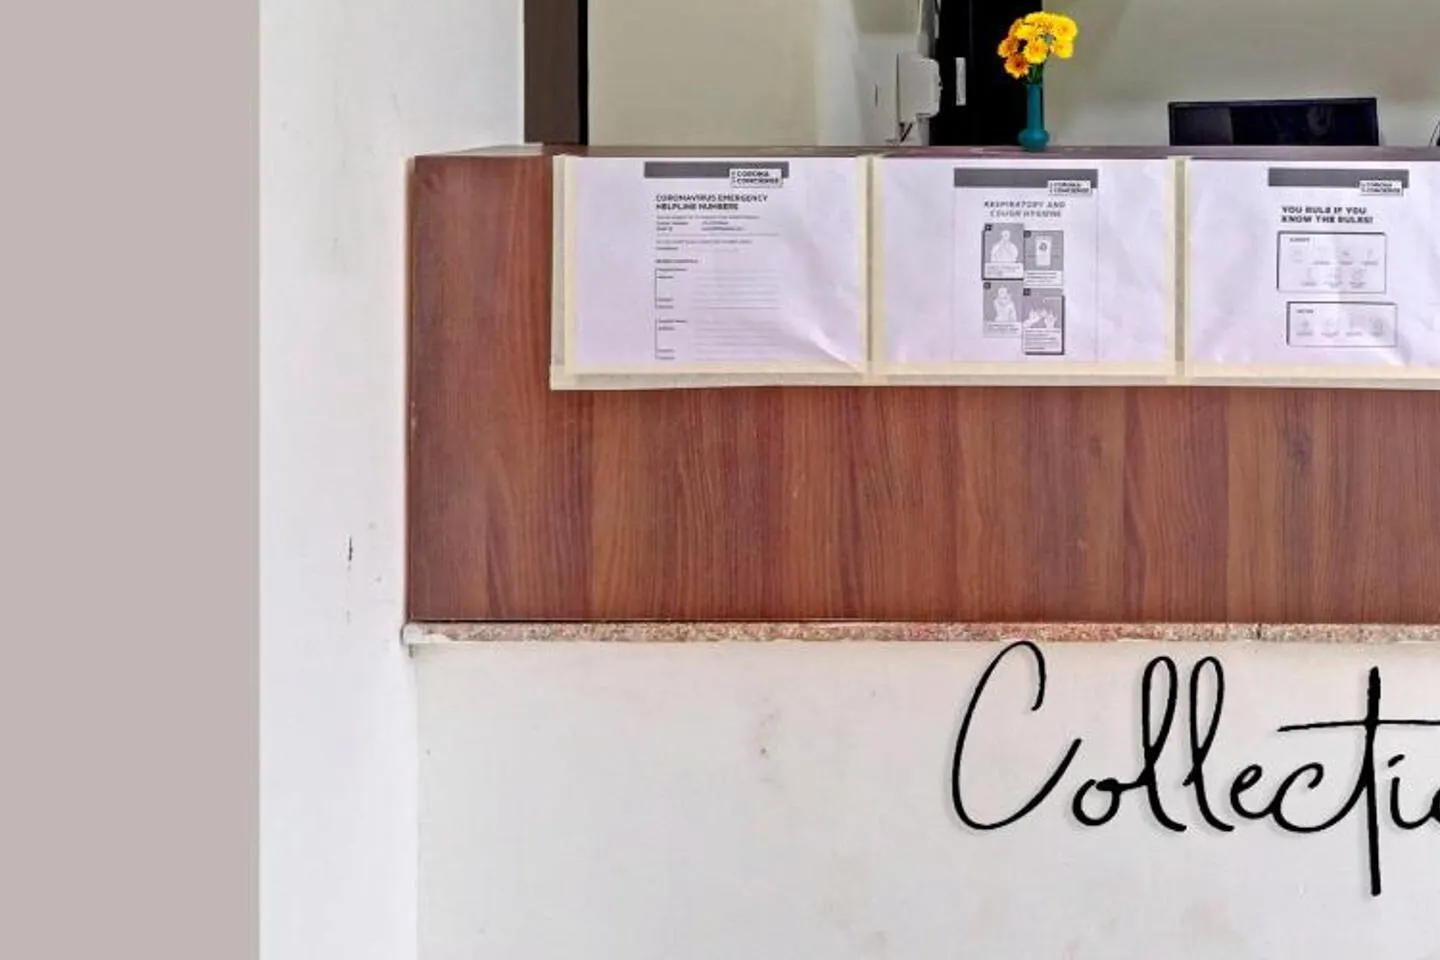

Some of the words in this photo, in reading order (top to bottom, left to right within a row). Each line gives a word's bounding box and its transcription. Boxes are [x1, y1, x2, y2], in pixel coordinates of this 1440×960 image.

[655, 194, 717, 202] CORONAVIRUS
[717, 194, 769, 202] EMERGENCY
[1281, 206, 1303, 214] YOU
[1333, 206, 1343, 214] IF
[1345, 207, 1367, 215] YOU
[1316, 216, 1335, 224] THE
